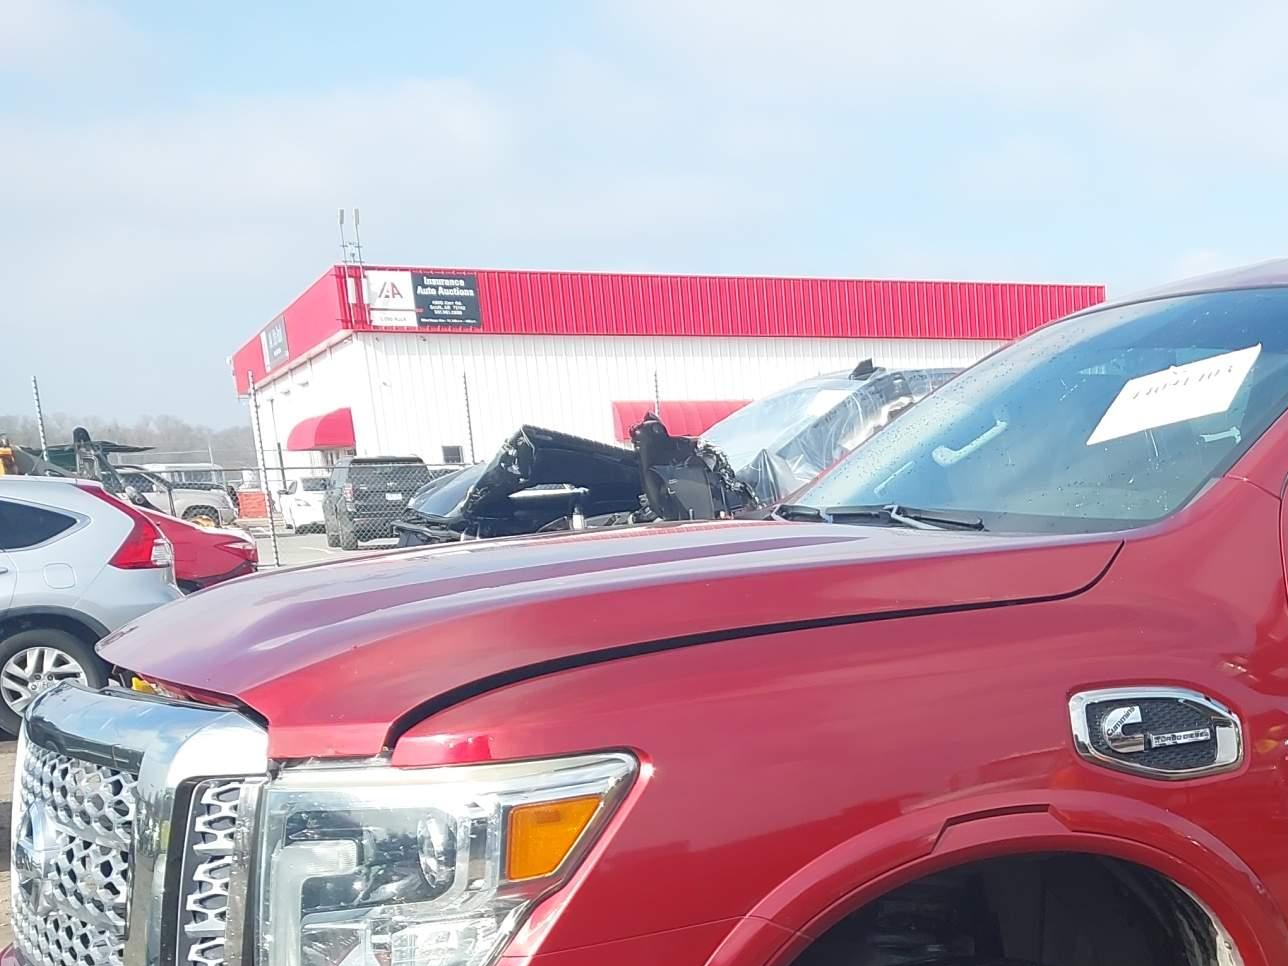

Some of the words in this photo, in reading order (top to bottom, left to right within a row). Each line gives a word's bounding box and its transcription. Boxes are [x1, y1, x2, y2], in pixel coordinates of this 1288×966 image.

[423, 276, 465, 286] Insurance
[417, 286, 437, 295] Auto
[438, 286, 474, 297] Auctions
[1106, 706, 1135, 737] Cummins
